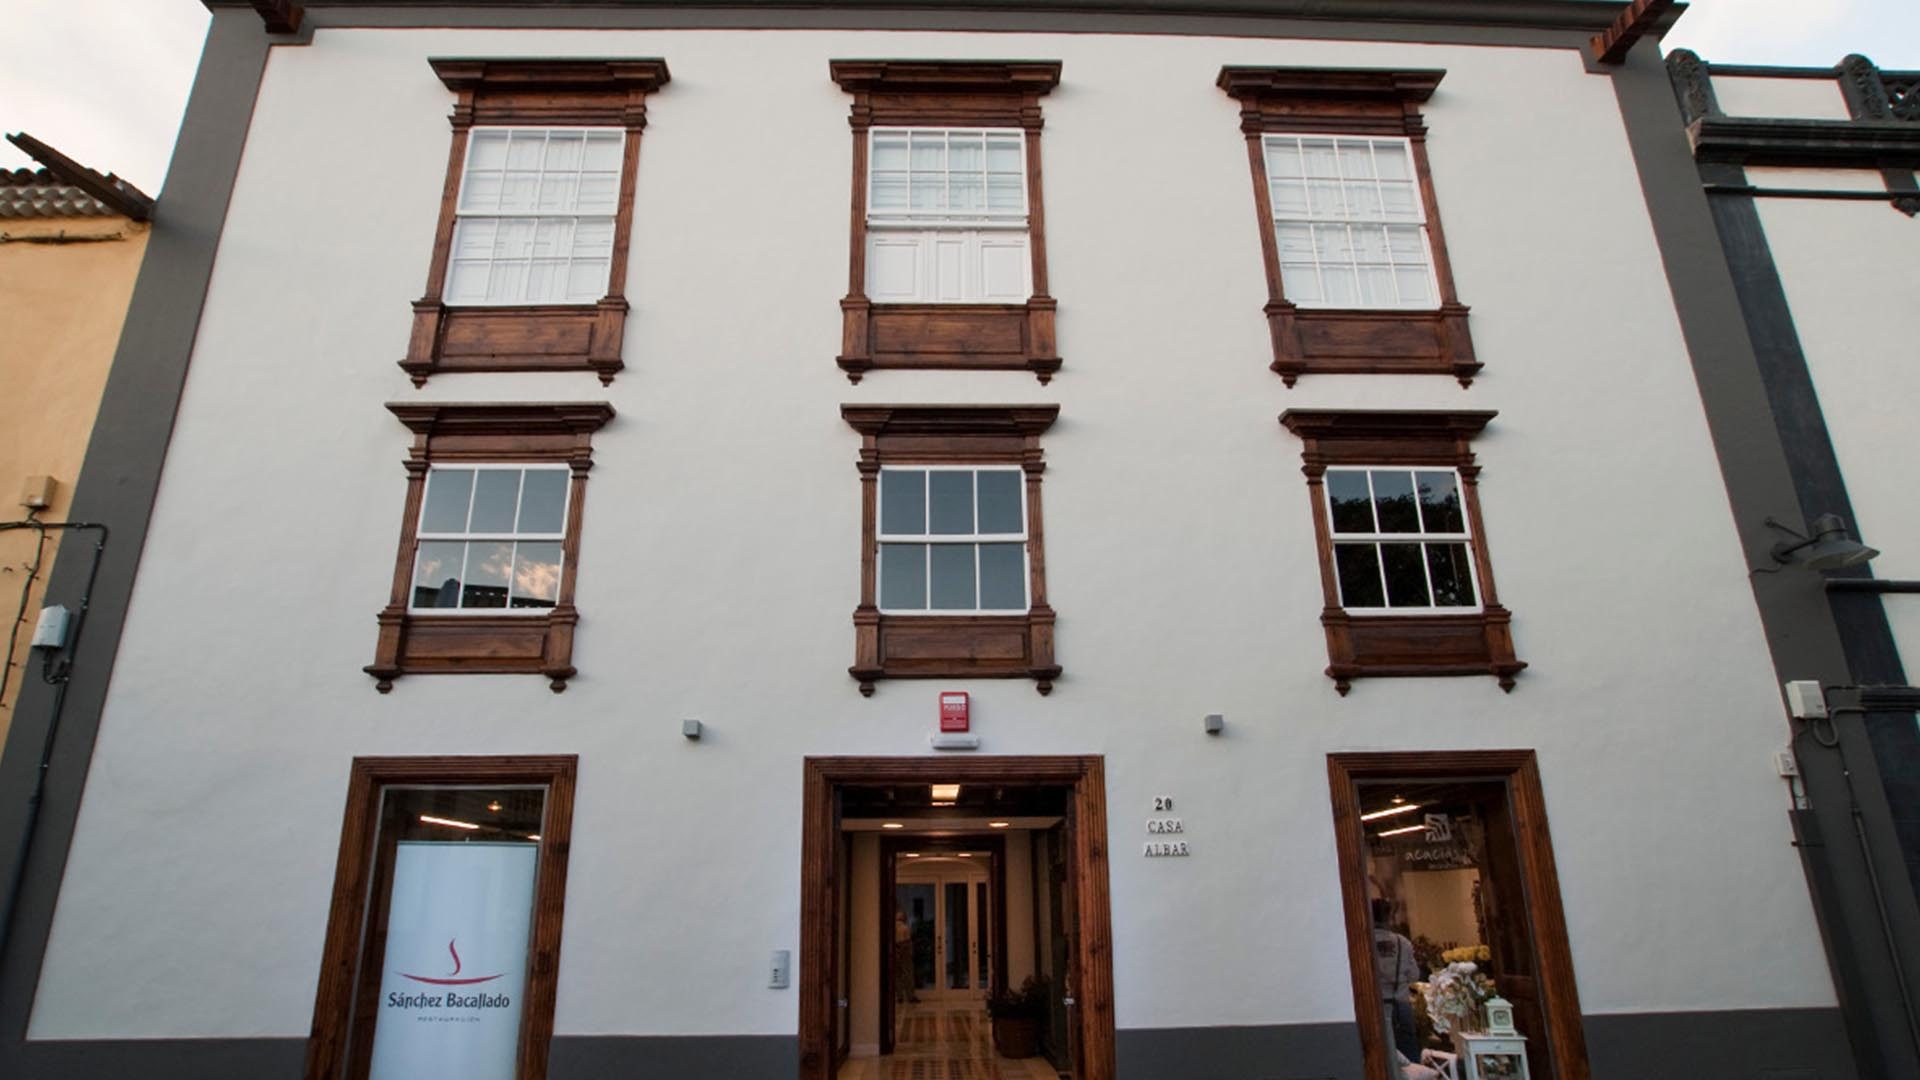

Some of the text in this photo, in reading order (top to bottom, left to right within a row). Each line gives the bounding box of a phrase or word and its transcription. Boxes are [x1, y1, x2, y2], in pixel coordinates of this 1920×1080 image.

[1155, 797, 1173, 811] 20
[1147, 820, 1184, 833] CASA
[1144, 842, 1190, 857] ALBAR
[388, 991, 510, 1009] Sánchez Bacallado
